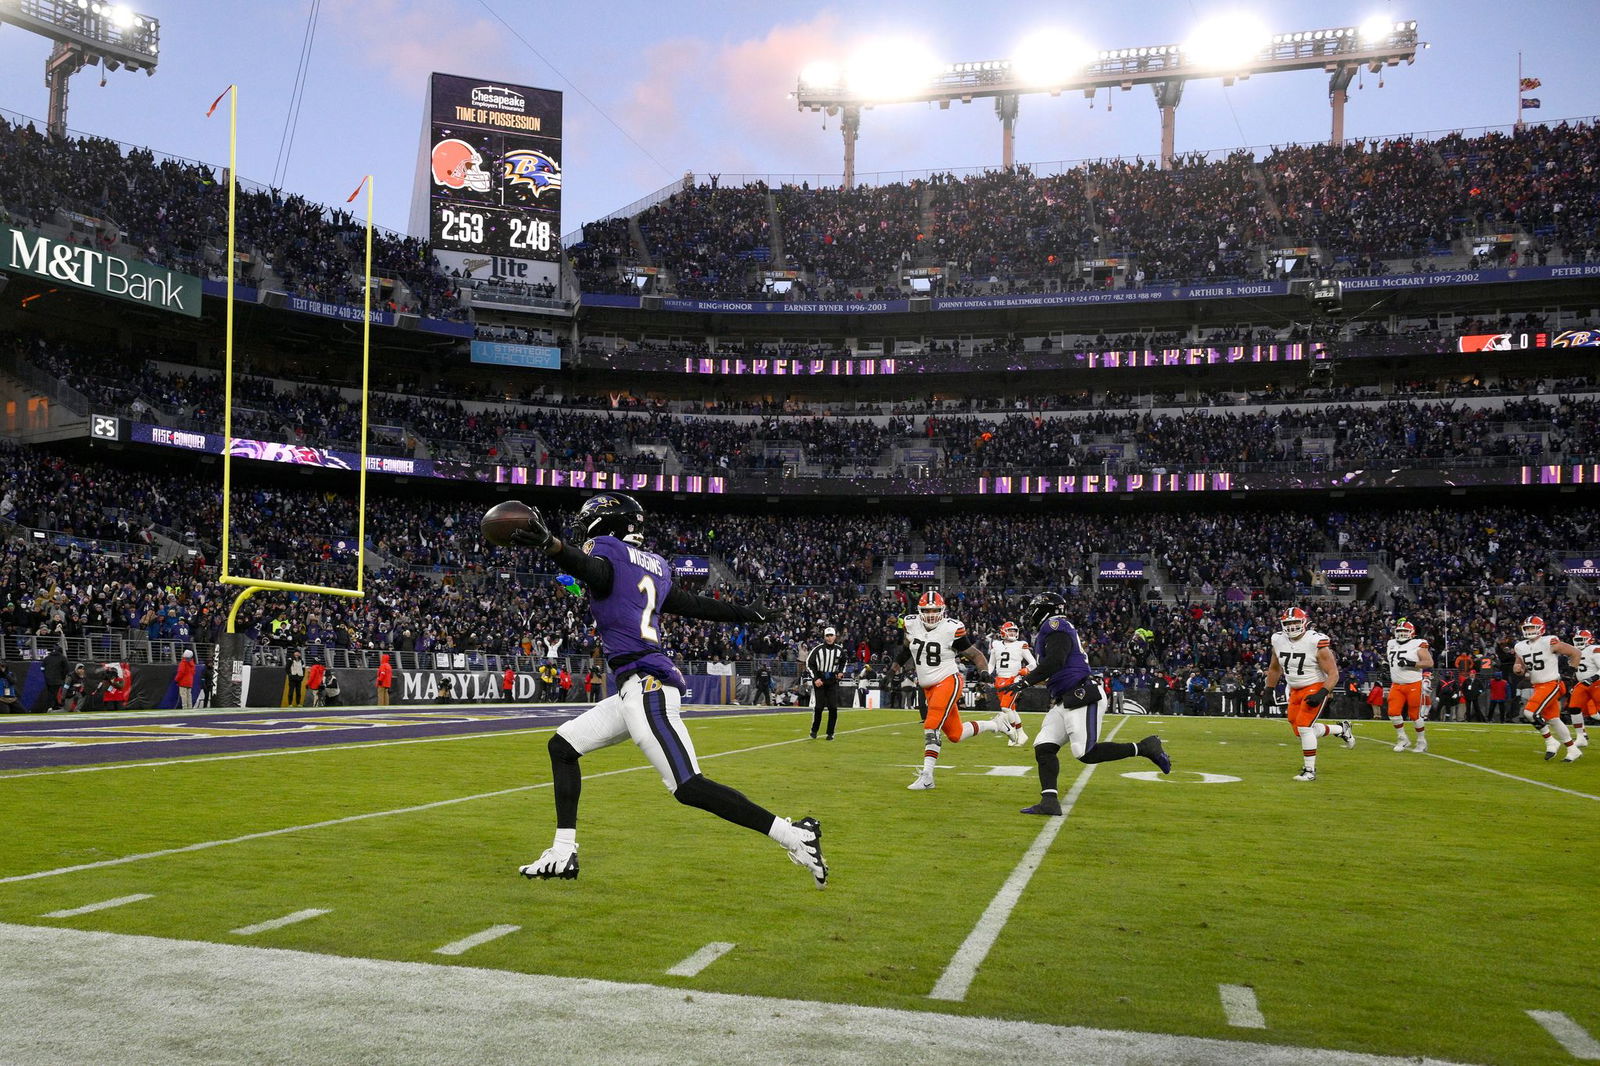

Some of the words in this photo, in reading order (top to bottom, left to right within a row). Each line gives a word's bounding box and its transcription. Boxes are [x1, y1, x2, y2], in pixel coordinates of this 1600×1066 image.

[472, 88, 525, 109] Chesapeake
[455, 106, 477, 124] TIME
[477, 110, 488, 124] OF
[489, 112, 541, 131] POSSESSION
[442, 209, 484, 244] 2:53
[509, 218, 551, 252] 2:48
[9, 229, 103, 288] M&T
[106, 256, 185, 310] Bank
[1551, 266, 1582, 276] PETER
[1341, 280, 1380, 289] MICHAEL
[1429, 274, 1480, 284] 1997-2002
[1189, 288, 1224, 297] ARTHUR
[1237, 286, 1272, 294] MODELL
[292, 298, 308, 310] TEXT
[309, 301, 322, 313] FOR
[322, 304, 338, 316] HELP
[698, 302, 717, 310] RING
[784, 304, 817, 312] EARNEST
[818, 304, 844, 312] BYNER
[846, 304, 887, 312] 1996-2003
[938, 302, 963, 310] JOHNNY
[1007, 298, 1042, 306] BALTIMORE
[1520, 333, 1528, 349] 0
[495, 346, 552, 357] STRATEGIC
[94, 418, 115, 437] 25
[152, 428, 172, 444] RISE
[174, 432, 206, 450] CONQUER
[366, 457, 381, 470] ISE
[383, 458, 414, 474] CONQUER
[626, 546, 663, 577] WIGGINS
[637, 574, 659, 644] 2
[912, 638, 941, 666] 78
[1000, 652, 1010, 668] 2
[1389, 650, 1408, 668] 75
[1279, 652, 1306, 676] 77
[1522, 652, 1545, 672] 55
